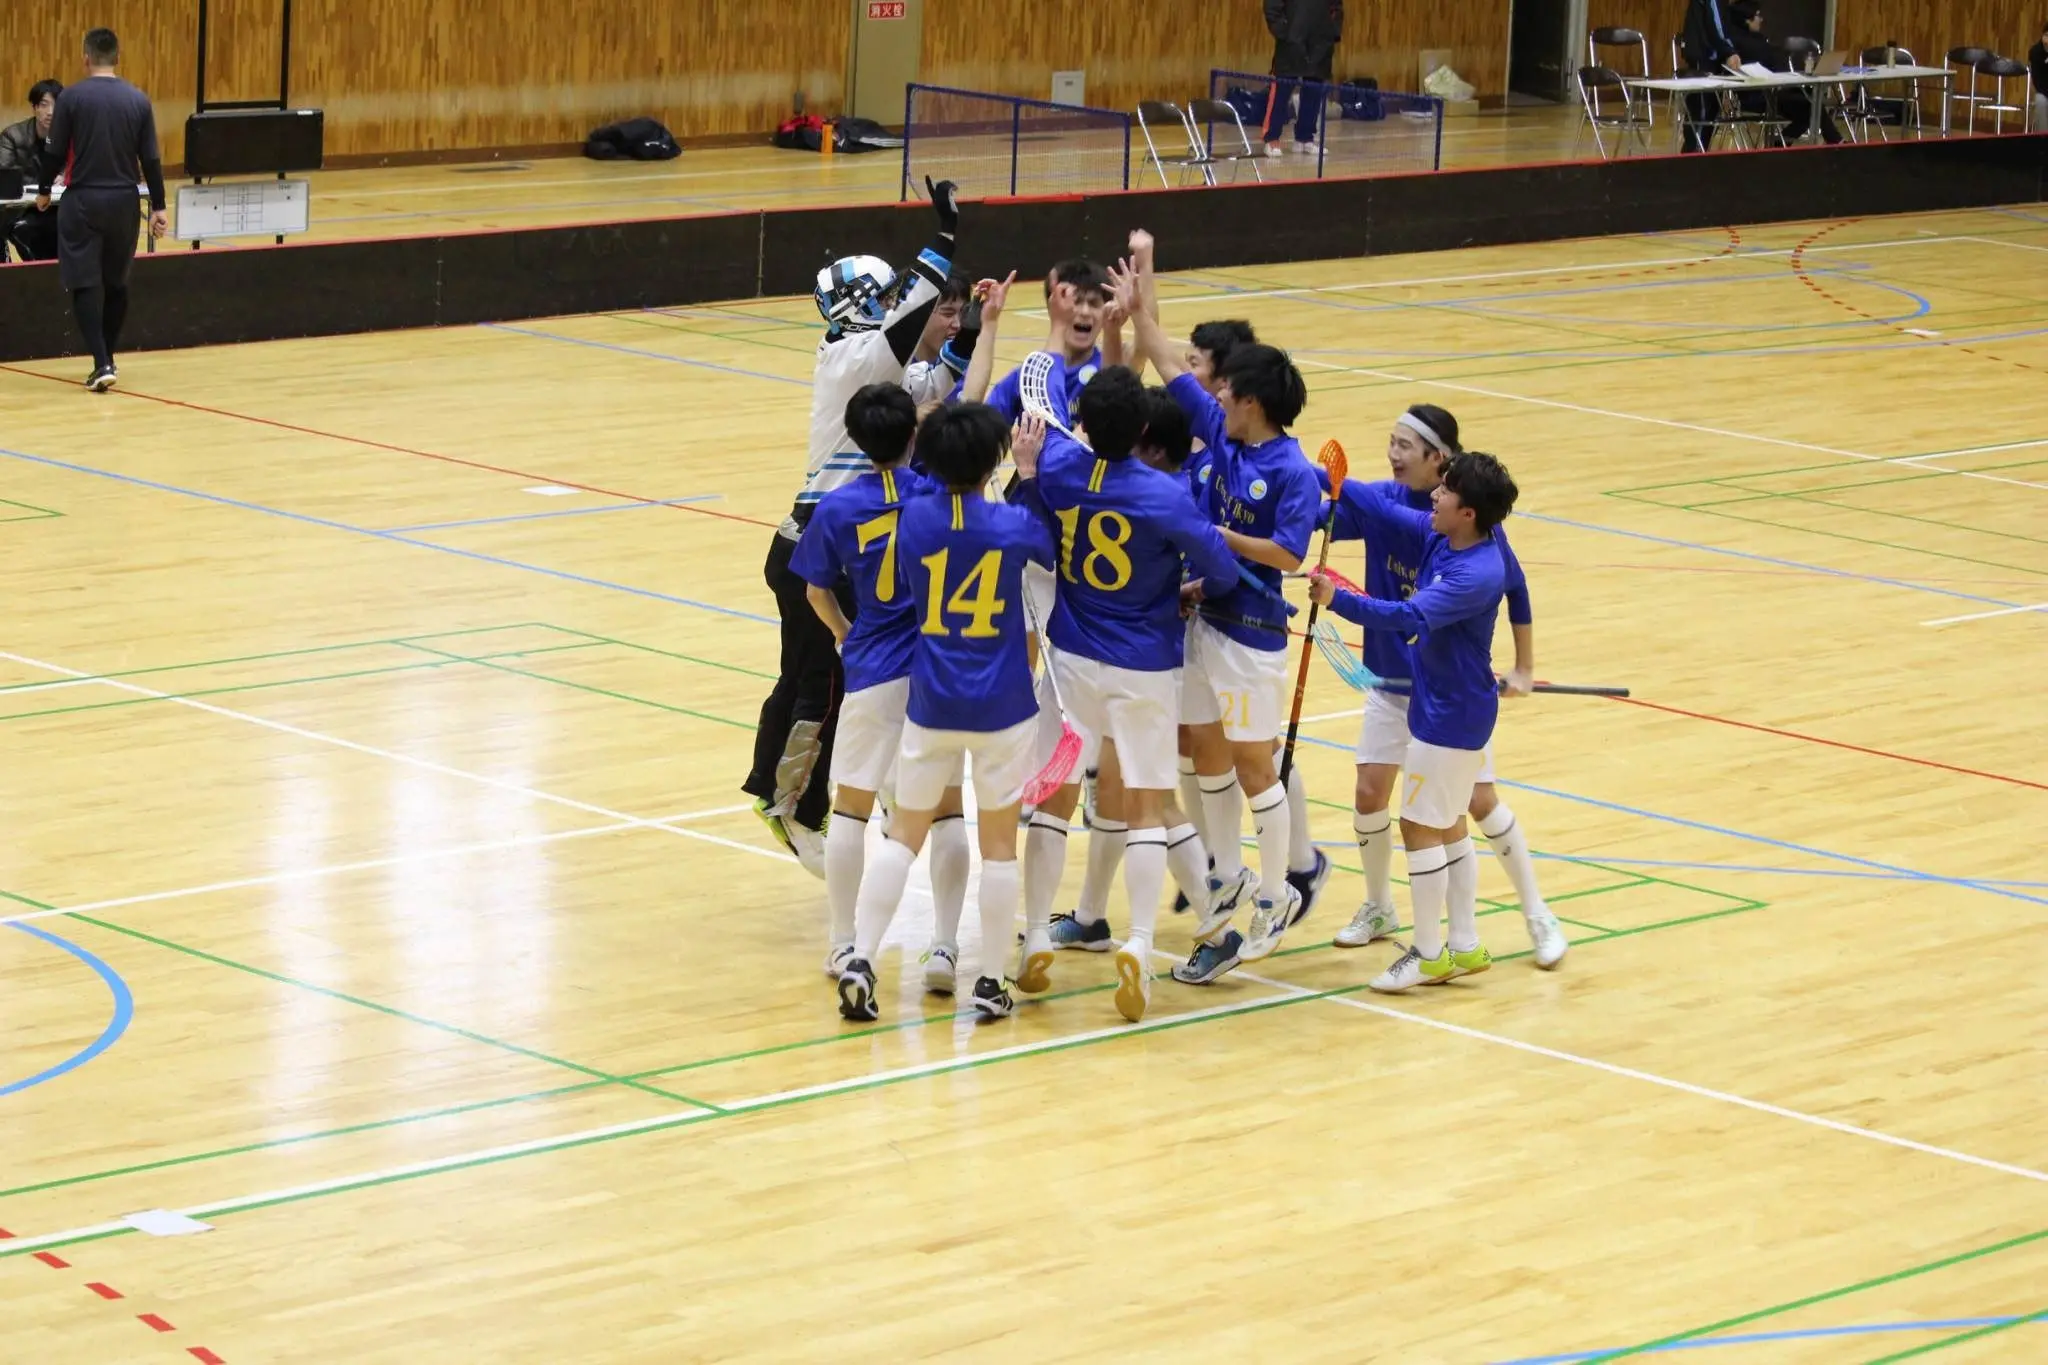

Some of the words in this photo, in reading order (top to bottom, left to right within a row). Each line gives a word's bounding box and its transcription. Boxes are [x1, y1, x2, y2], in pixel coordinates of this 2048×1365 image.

[871, 3, 903, 17] 消火栓
[856, 510, 899, 602] 7
[1055, 505, 1133, 591] 18
[920, 547, 1006, 638] 14
[1218, 691, 1251, 729] 21
[1406, 772, 1426, 806] 7
